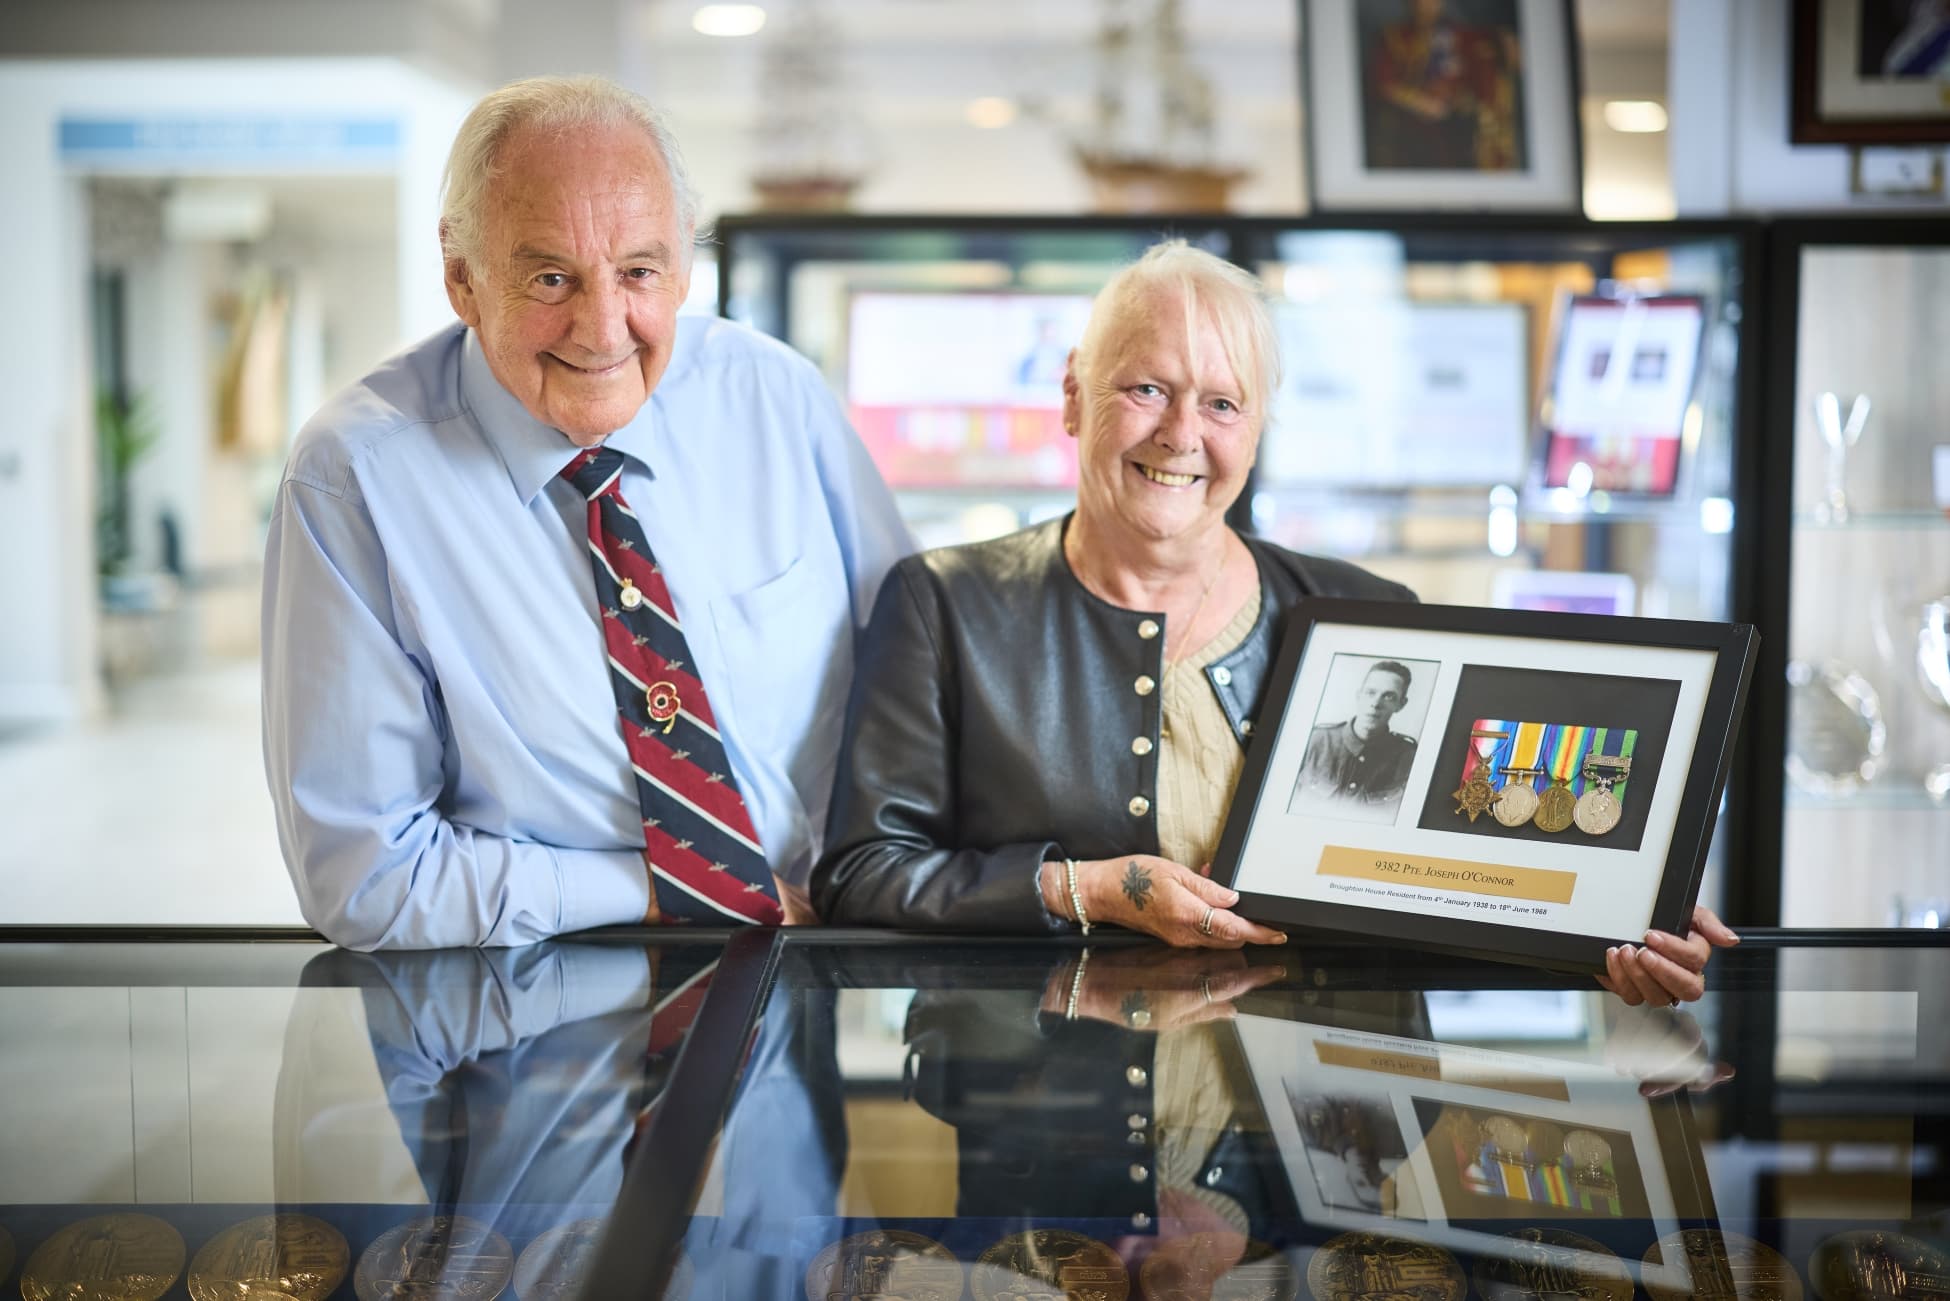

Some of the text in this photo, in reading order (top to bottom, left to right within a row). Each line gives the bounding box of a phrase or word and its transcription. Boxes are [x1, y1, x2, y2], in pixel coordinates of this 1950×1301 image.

[1375, 860, 1400, 873] 9382
[1329, 882, 1364, 893] Broughton
[1365, 887, 1386, 896] House
[1387, 890, 1416, 900] Resident
[1417, 893, 1433, 902] from
[1444, 898, 1471, 908] January
[1473, 901, 1489, 909] 1938
[1513, 906, 1530, 914] June
